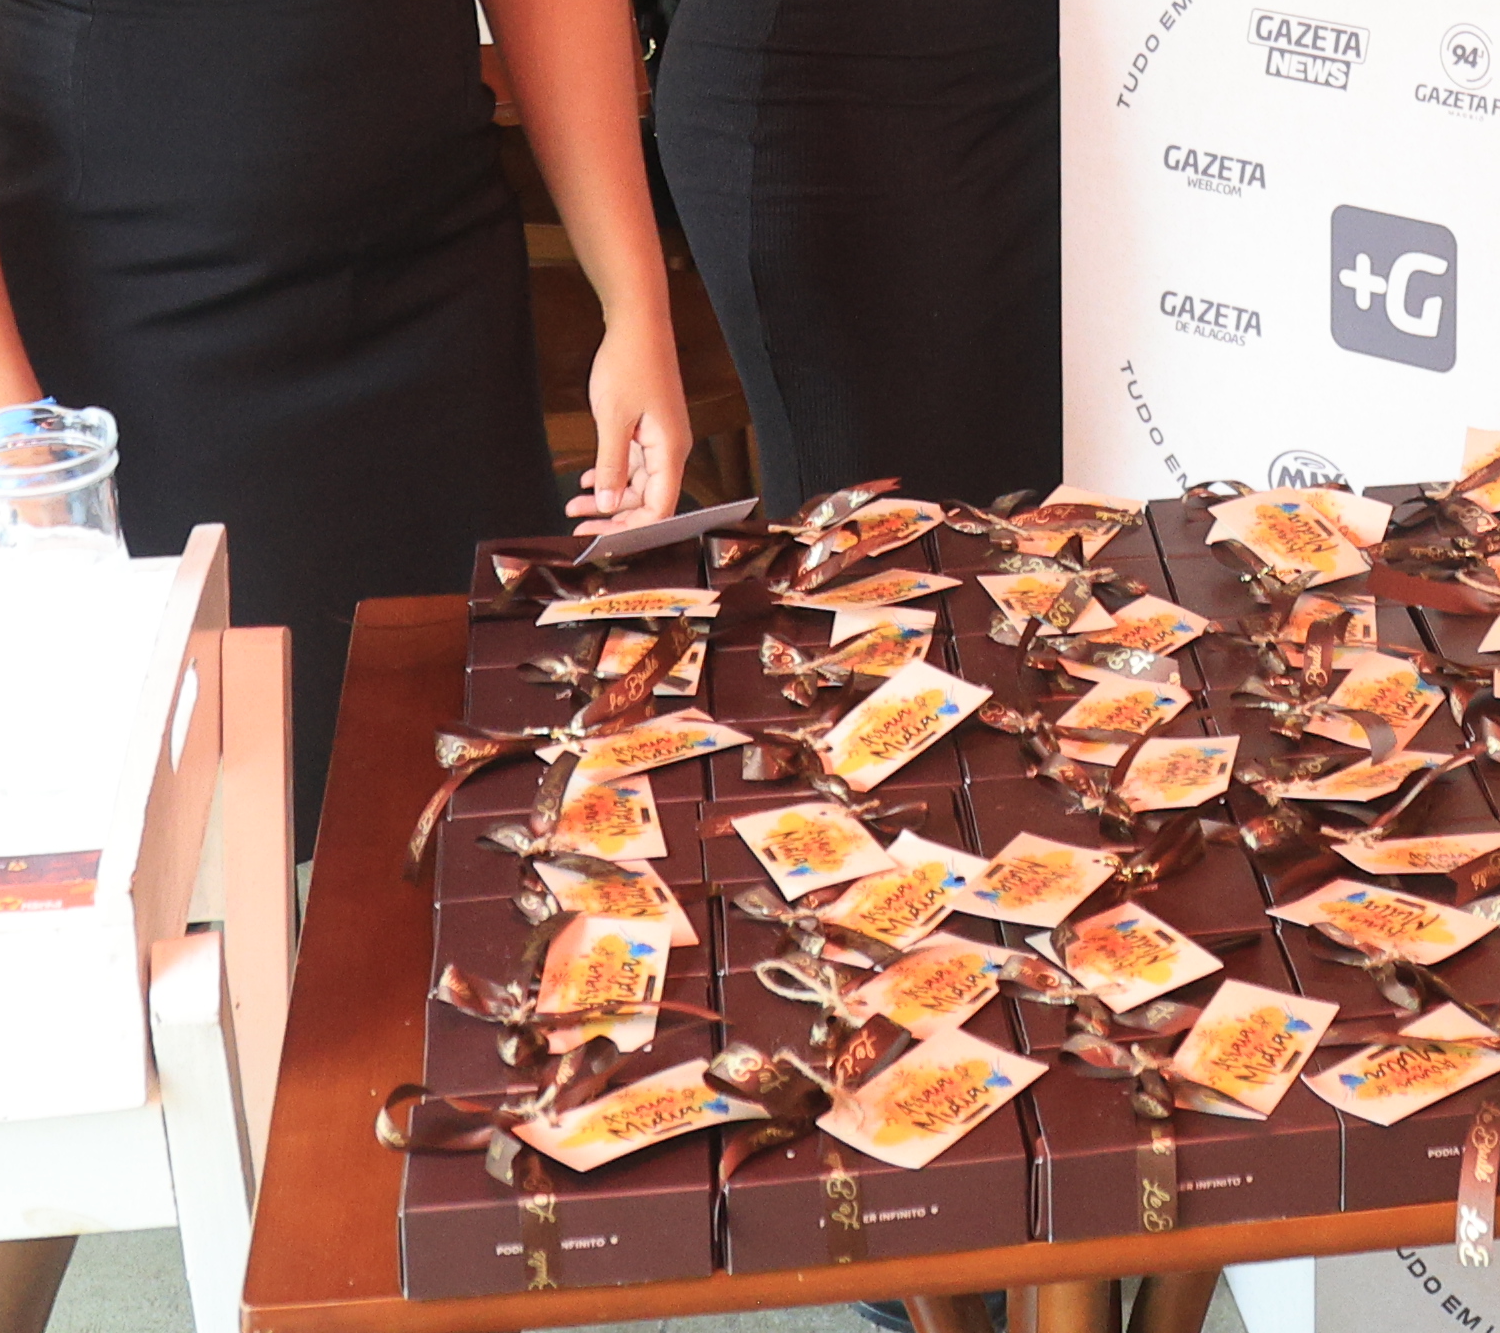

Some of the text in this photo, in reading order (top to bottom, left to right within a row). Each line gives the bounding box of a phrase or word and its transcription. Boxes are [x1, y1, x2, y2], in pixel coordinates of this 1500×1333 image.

[1254, 14, 1363, 59] GAZETA
[1116, 33, 1160, 110] TUDO
[1269, 49, 1350, 90] NEWS
[1414, 83, 1489, 116] GAZETA
[1163, 144, 1266, 190] GAZETA
[1186, 175, 1243, 199] WEB.COM
[1159, 290, 1263, 338] GAZETA
[1338, 251, 1450, 339] +G
[1175, 319, 1247, 347] DE ALAGOAS
[1120, 360, 1165, 447] TUDO
[495, 1236, 606, 1257] PODI NFINITO
[1395, 1246, 1484, 1332] UDO EM
